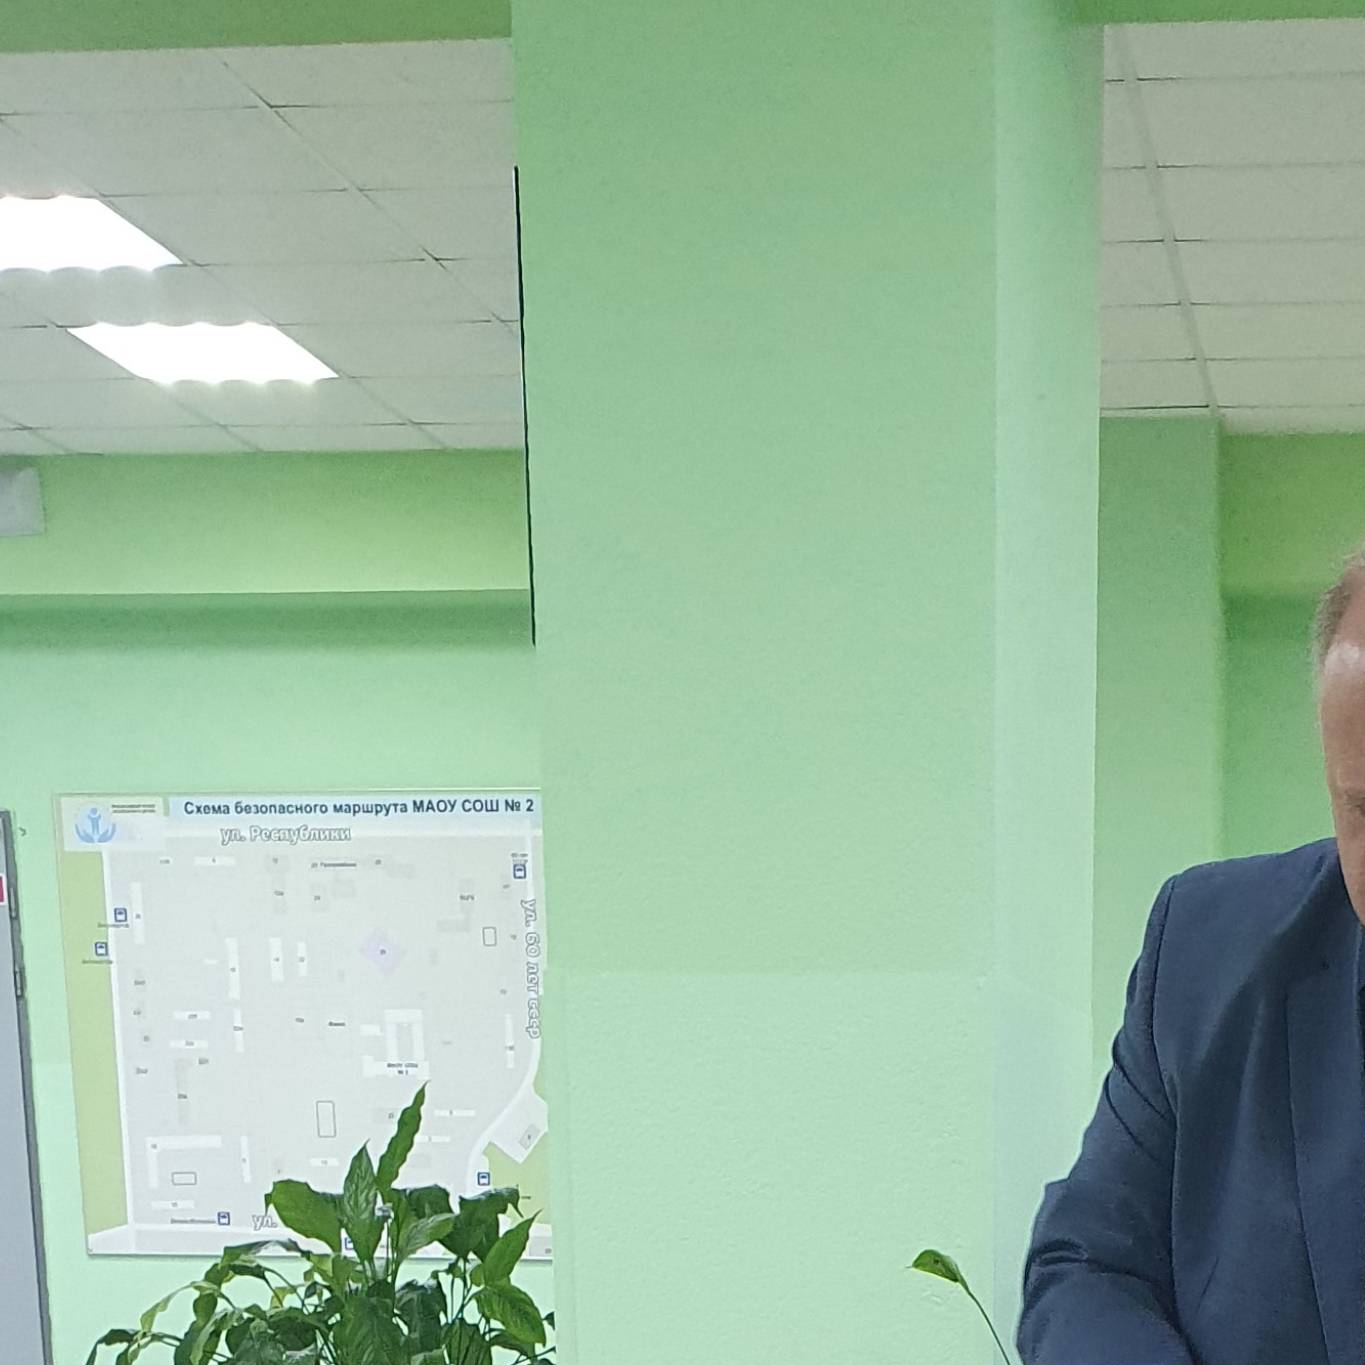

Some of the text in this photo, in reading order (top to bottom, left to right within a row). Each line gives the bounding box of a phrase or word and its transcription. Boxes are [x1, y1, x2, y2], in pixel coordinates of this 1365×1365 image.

[183, 801, 230, 816] Схема
[234, 800, 329, 816] безопасного
[333, 800, 408, 819] маршрута
[412, 799, 456, 816] МАОУ
[462, 798, 501, 815] СОШ
[525, 798, 535, 813] 2
[220, 824, 352, 846] ул. Республики
[520, 899, 537, 927] ул.
[525, 932, 540, 958] 60
[526, 961, 538, 994] лет
[252, 1214, 278, 1231] ул.
